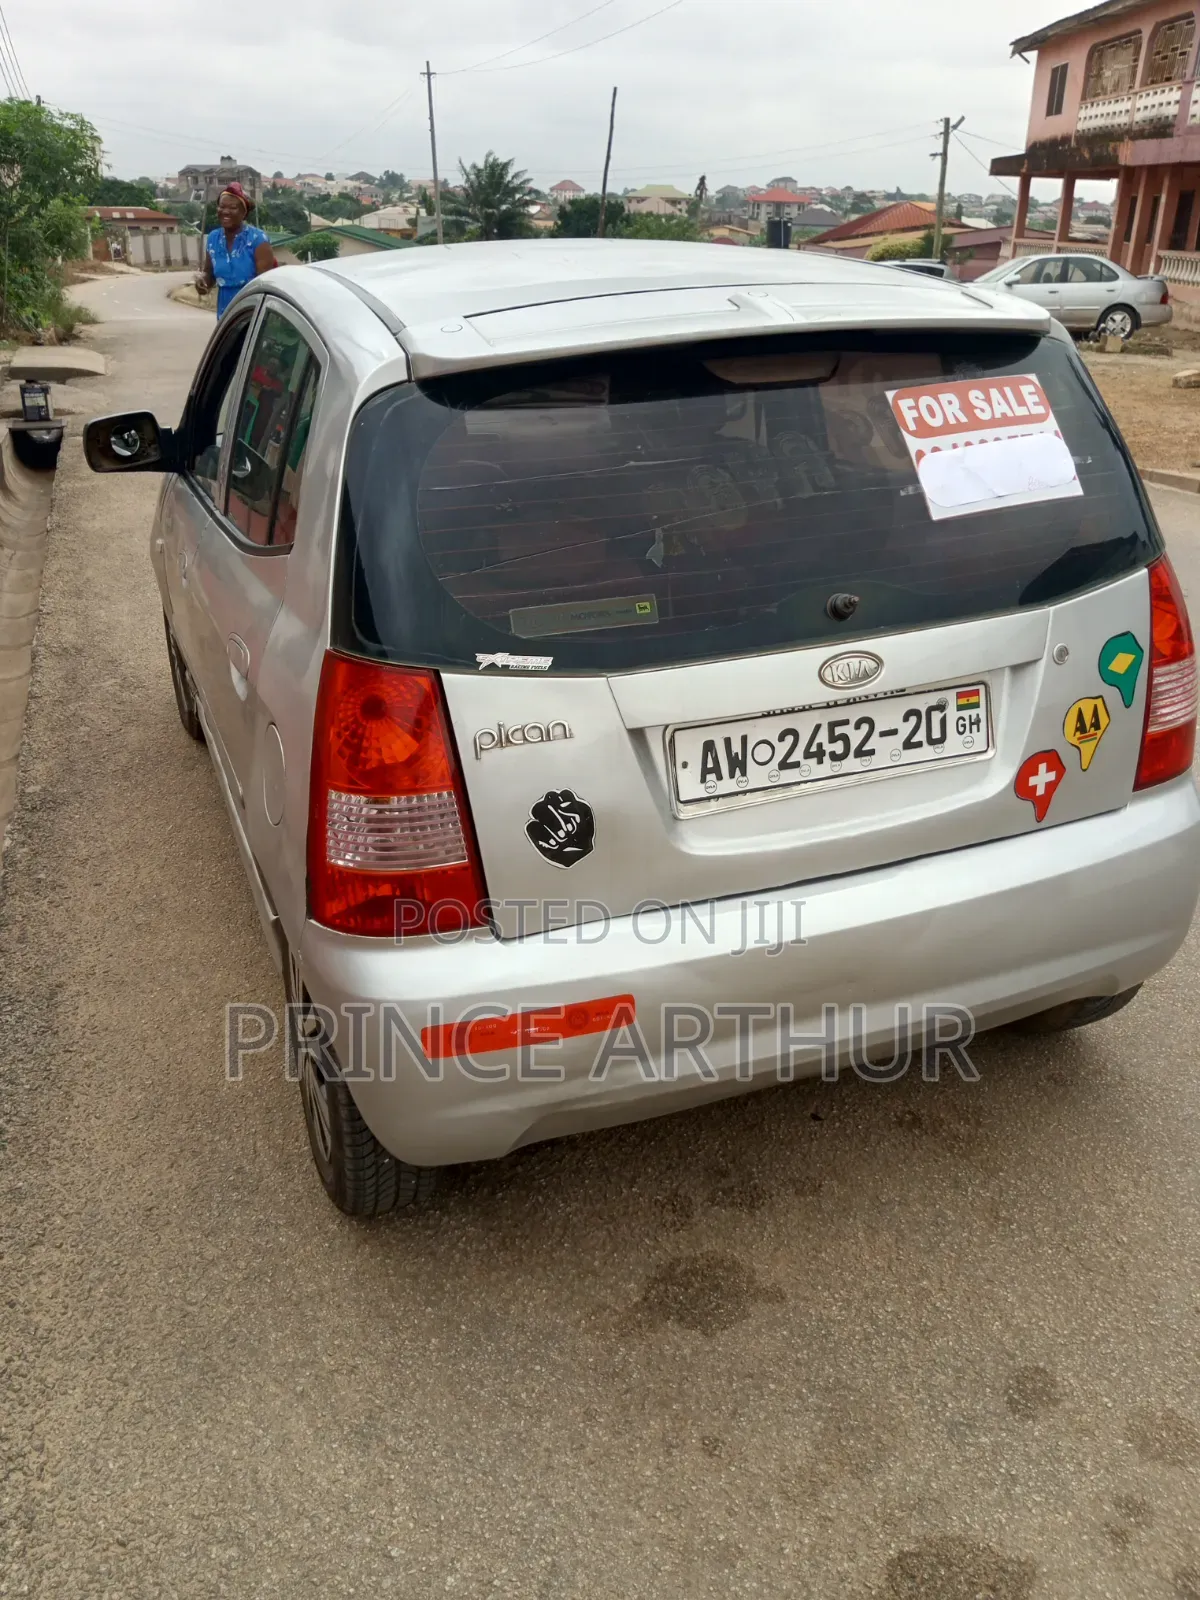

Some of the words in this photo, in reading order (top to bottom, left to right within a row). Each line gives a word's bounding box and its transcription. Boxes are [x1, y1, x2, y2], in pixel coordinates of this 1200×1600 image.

[898, 392, 968, 431] FOR
[968, 385, 1046, 420] SALE
[830, 659, 876, 683] KIA
[955, 713, 981, 735] GH
[1073, 704, 1101, 737] AA
[474, 720, 573, 760] pican
